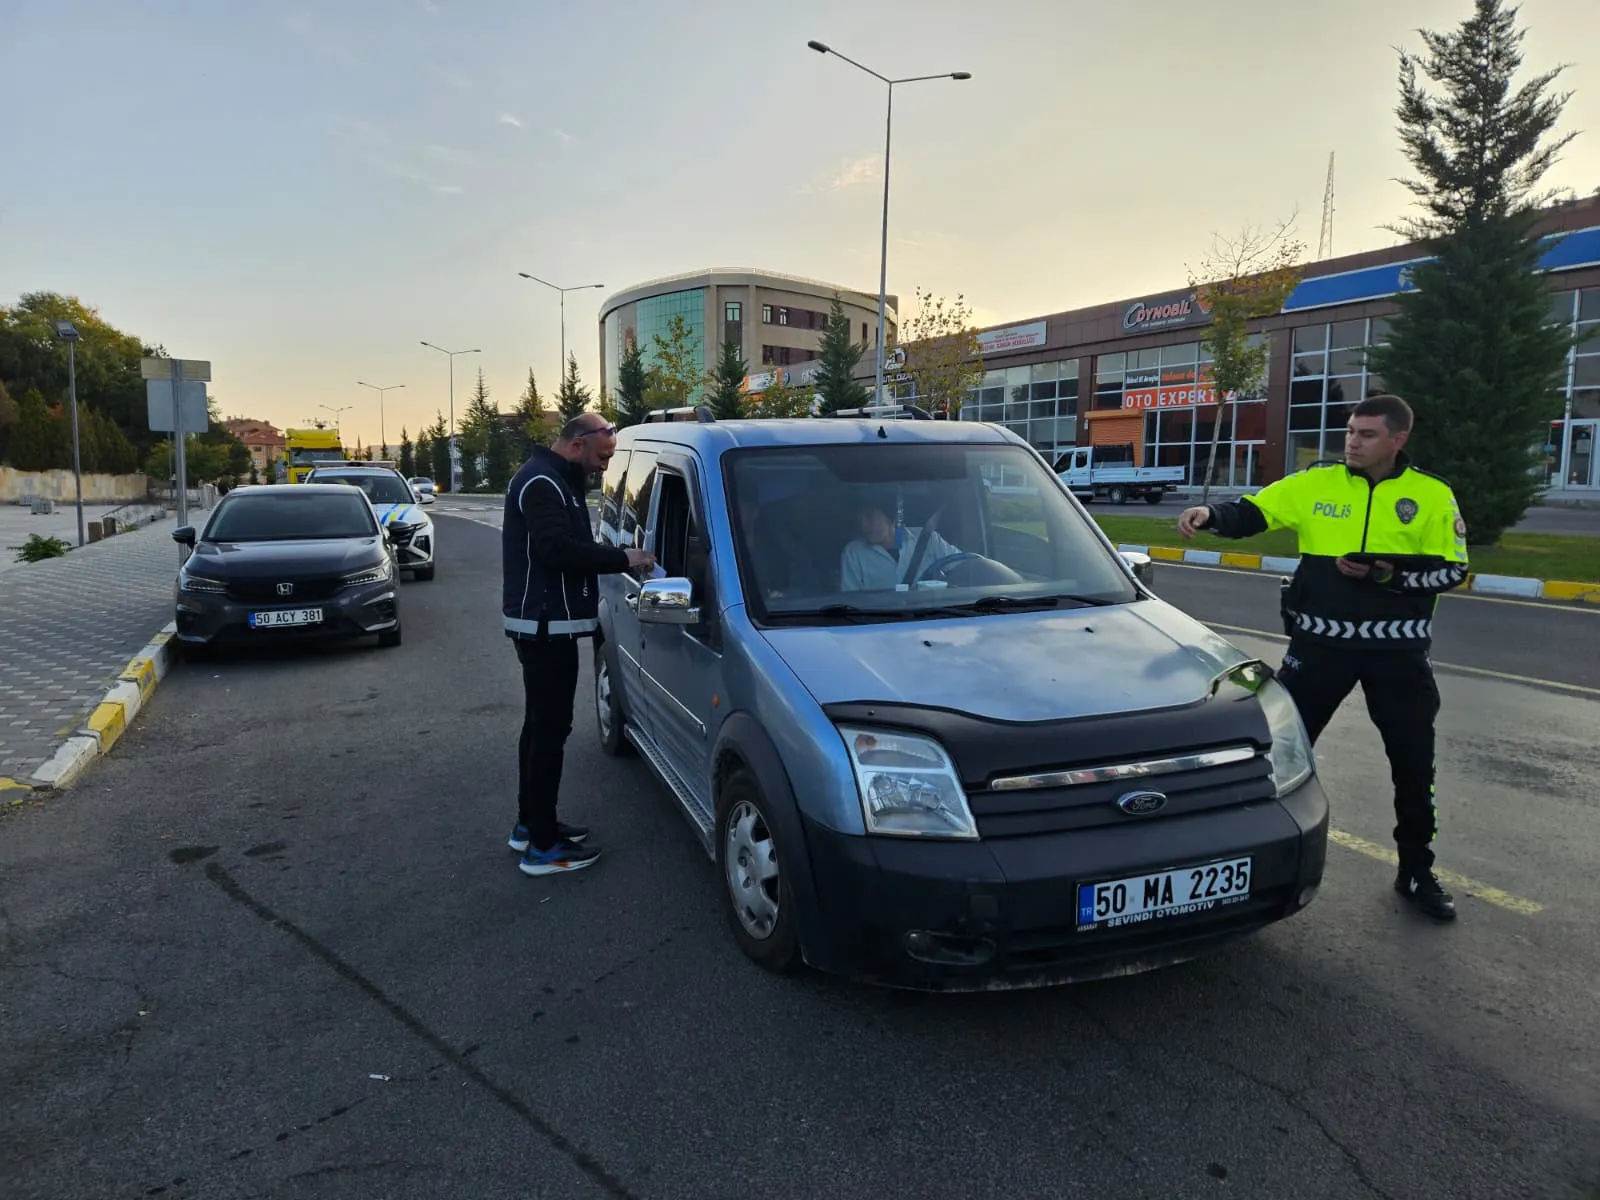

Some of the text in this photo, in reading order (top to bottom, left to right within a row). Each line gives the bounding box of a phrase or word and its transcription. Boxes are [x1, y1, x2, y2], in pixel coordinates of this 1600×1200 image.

[1126, 394, 1152, 408] OTO
[1313, 501, 1352, 518] POLİS
[256, 610, 321, 625] 50 ACY 381
[1096, 861, 1249, 917] 50 MA 2235
[1081, 907, 1092, 917] TR
